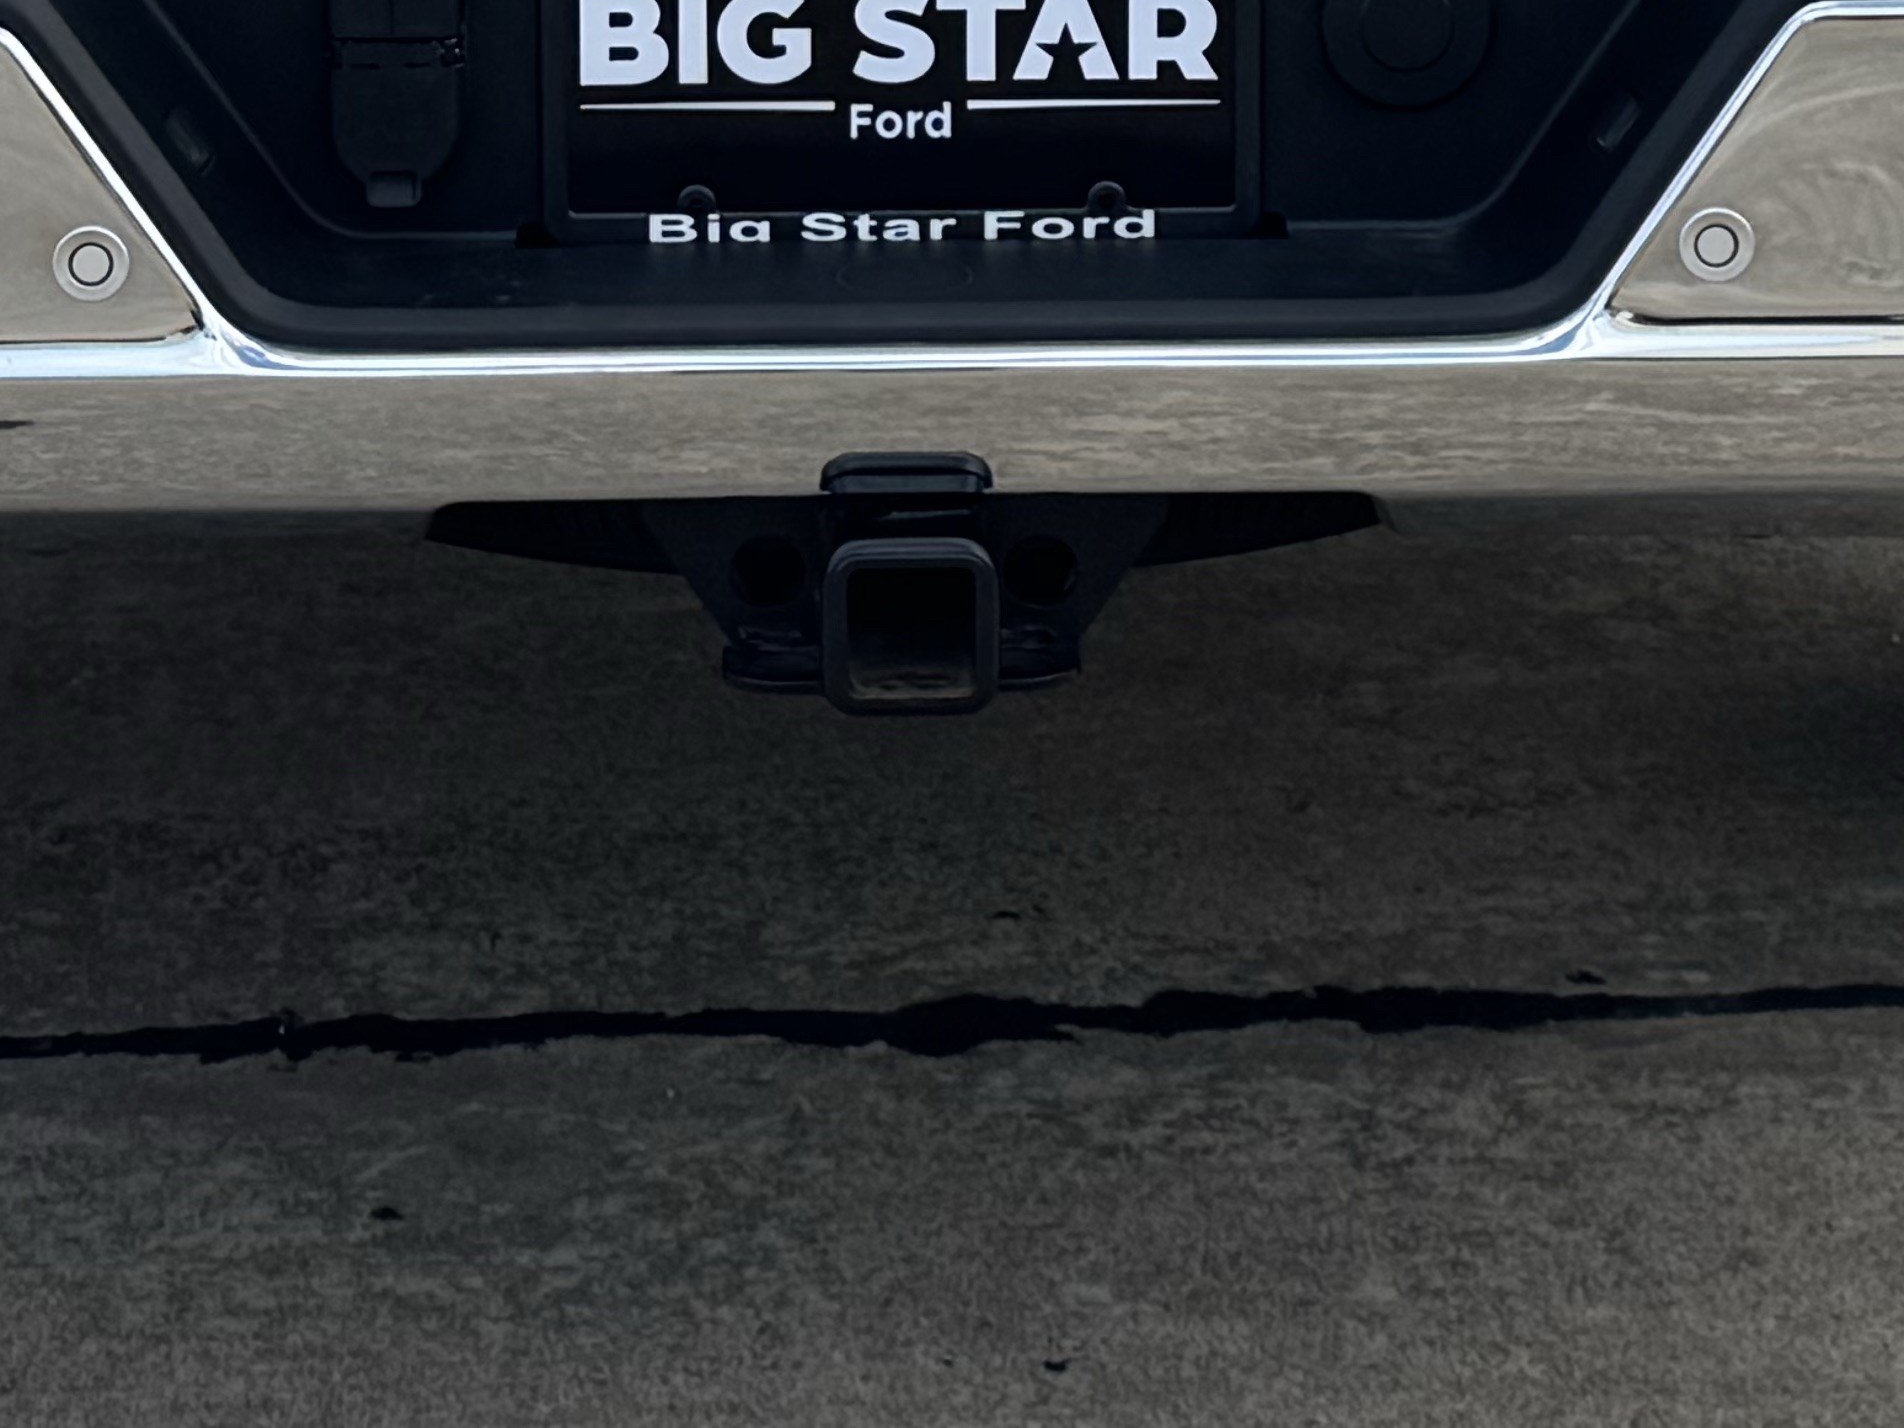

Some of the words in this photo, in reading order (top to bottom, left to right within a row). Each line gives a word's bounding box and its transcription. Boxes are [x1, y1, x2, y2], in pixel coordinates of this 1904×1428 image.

[849, 101, 953, 140] Ford
[800, 212, 958, 242] Star
[982, 208, 1156, 240] Ford
